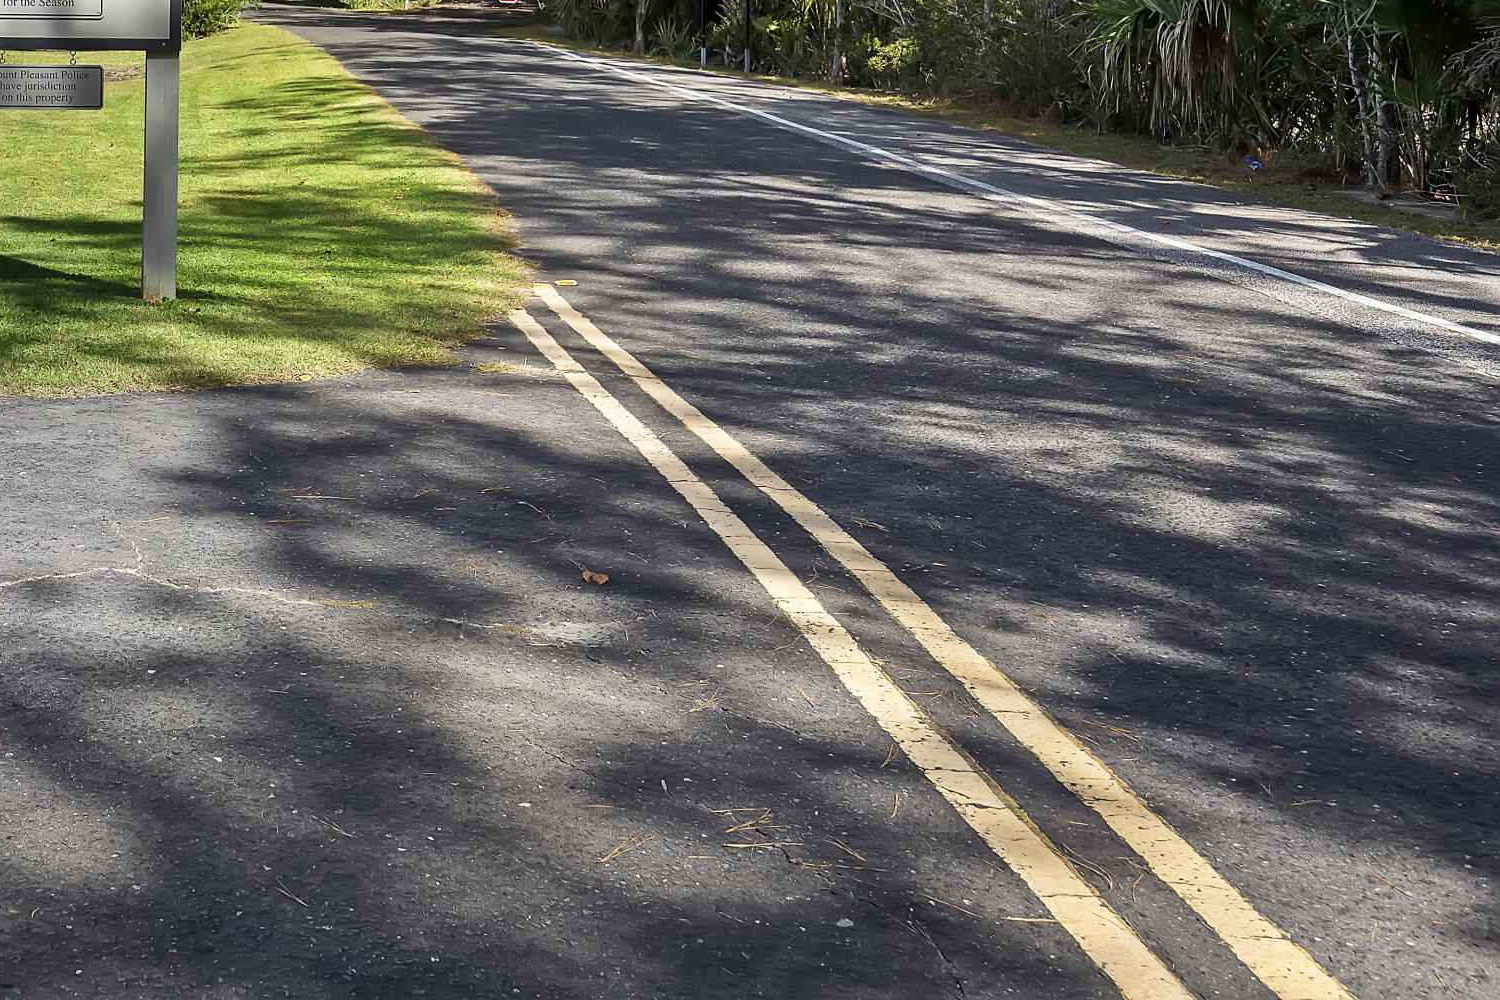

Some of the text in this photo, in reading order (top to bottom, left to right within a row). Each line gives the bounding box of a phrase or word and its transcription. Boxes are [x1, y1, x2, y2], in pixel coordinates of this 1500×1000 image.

[20, 70, 58, 80] Pleasant
[61, 70, 90, 80] Police
[0, 81, 76, 92] have jurisdiction
[16, 92, 33, 102] this
[35, 94, 74, 104] property
